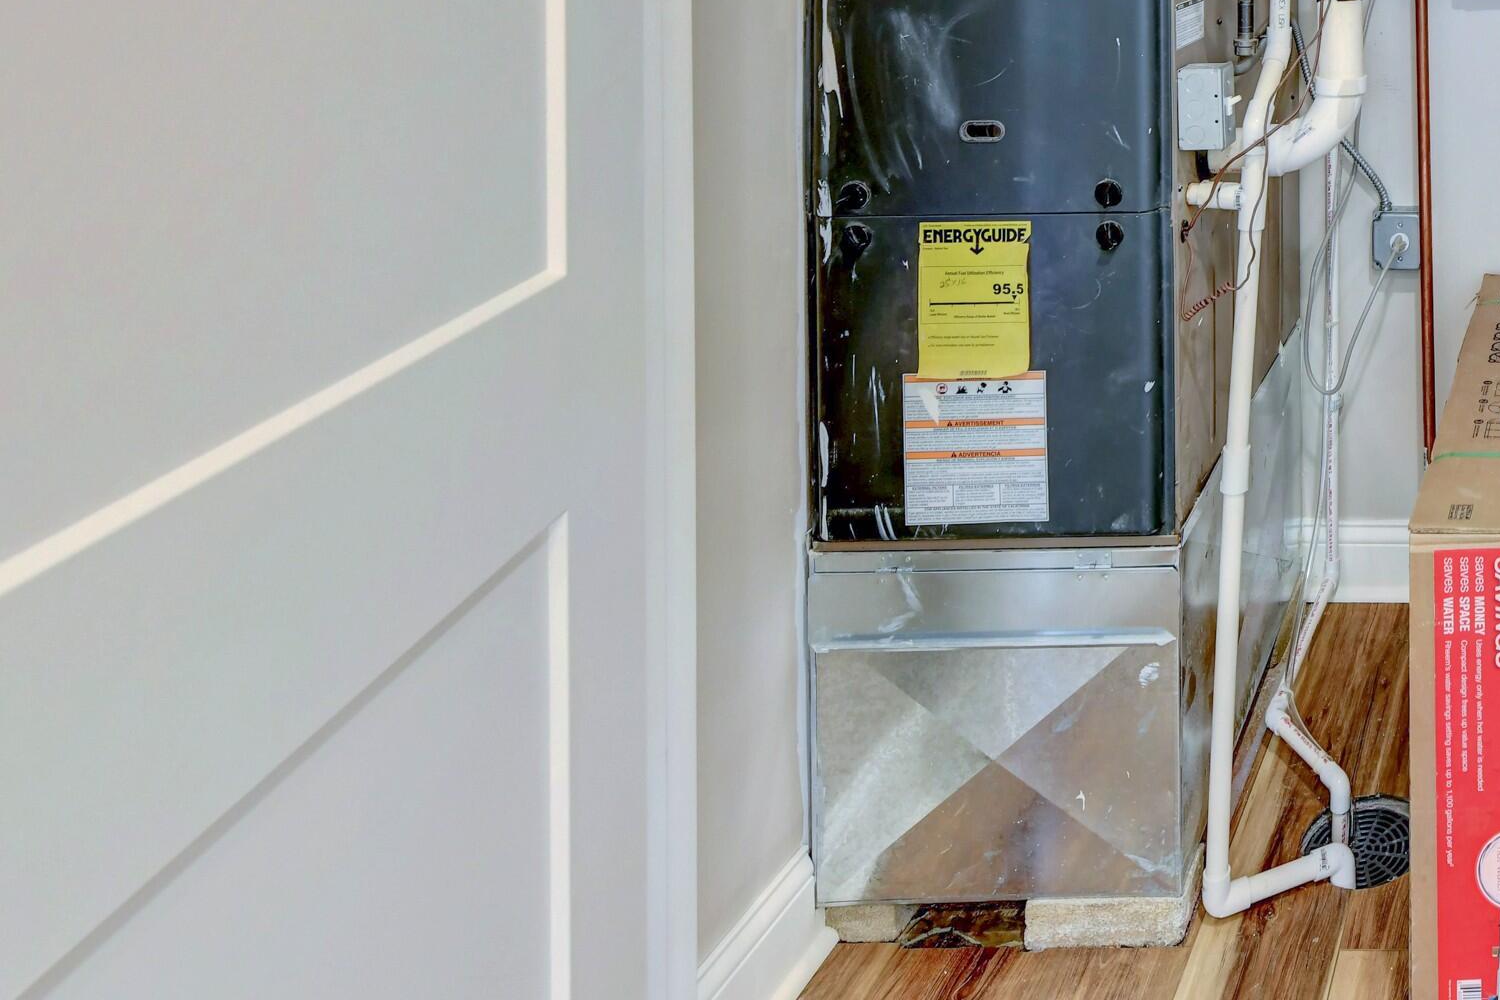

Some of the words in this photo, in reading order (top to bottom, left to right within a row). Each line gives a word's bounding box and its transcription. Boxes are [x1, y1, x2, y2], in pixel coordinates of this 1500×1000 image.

[923, 228, 1027, 243] ENERGYGUIDE
[992, 283, 1024, 295] 95.5
[1443, 556, 1454, 594] saves
[1460, 556, 1470, 593] saves
[1475, 556, 1485, 593] saves
[1443, 597, 1455, 635] WATER
[1459, 596, 1471, 632] SPACE
[1474, 595, 1486, 635] MONEY
[1460, 639, 1468, 673] Compact
[1474, 658, 1482, 683] energy
[1459, 673, 1469, 698] design
[1474, 684, 1484, 701] only
[1476, 700, 1484, 721] when
[1476, 721, 1484, 734] hot
[1444, 809, 1454, 835] gallons
[1445, 835, 1453, 849] per
